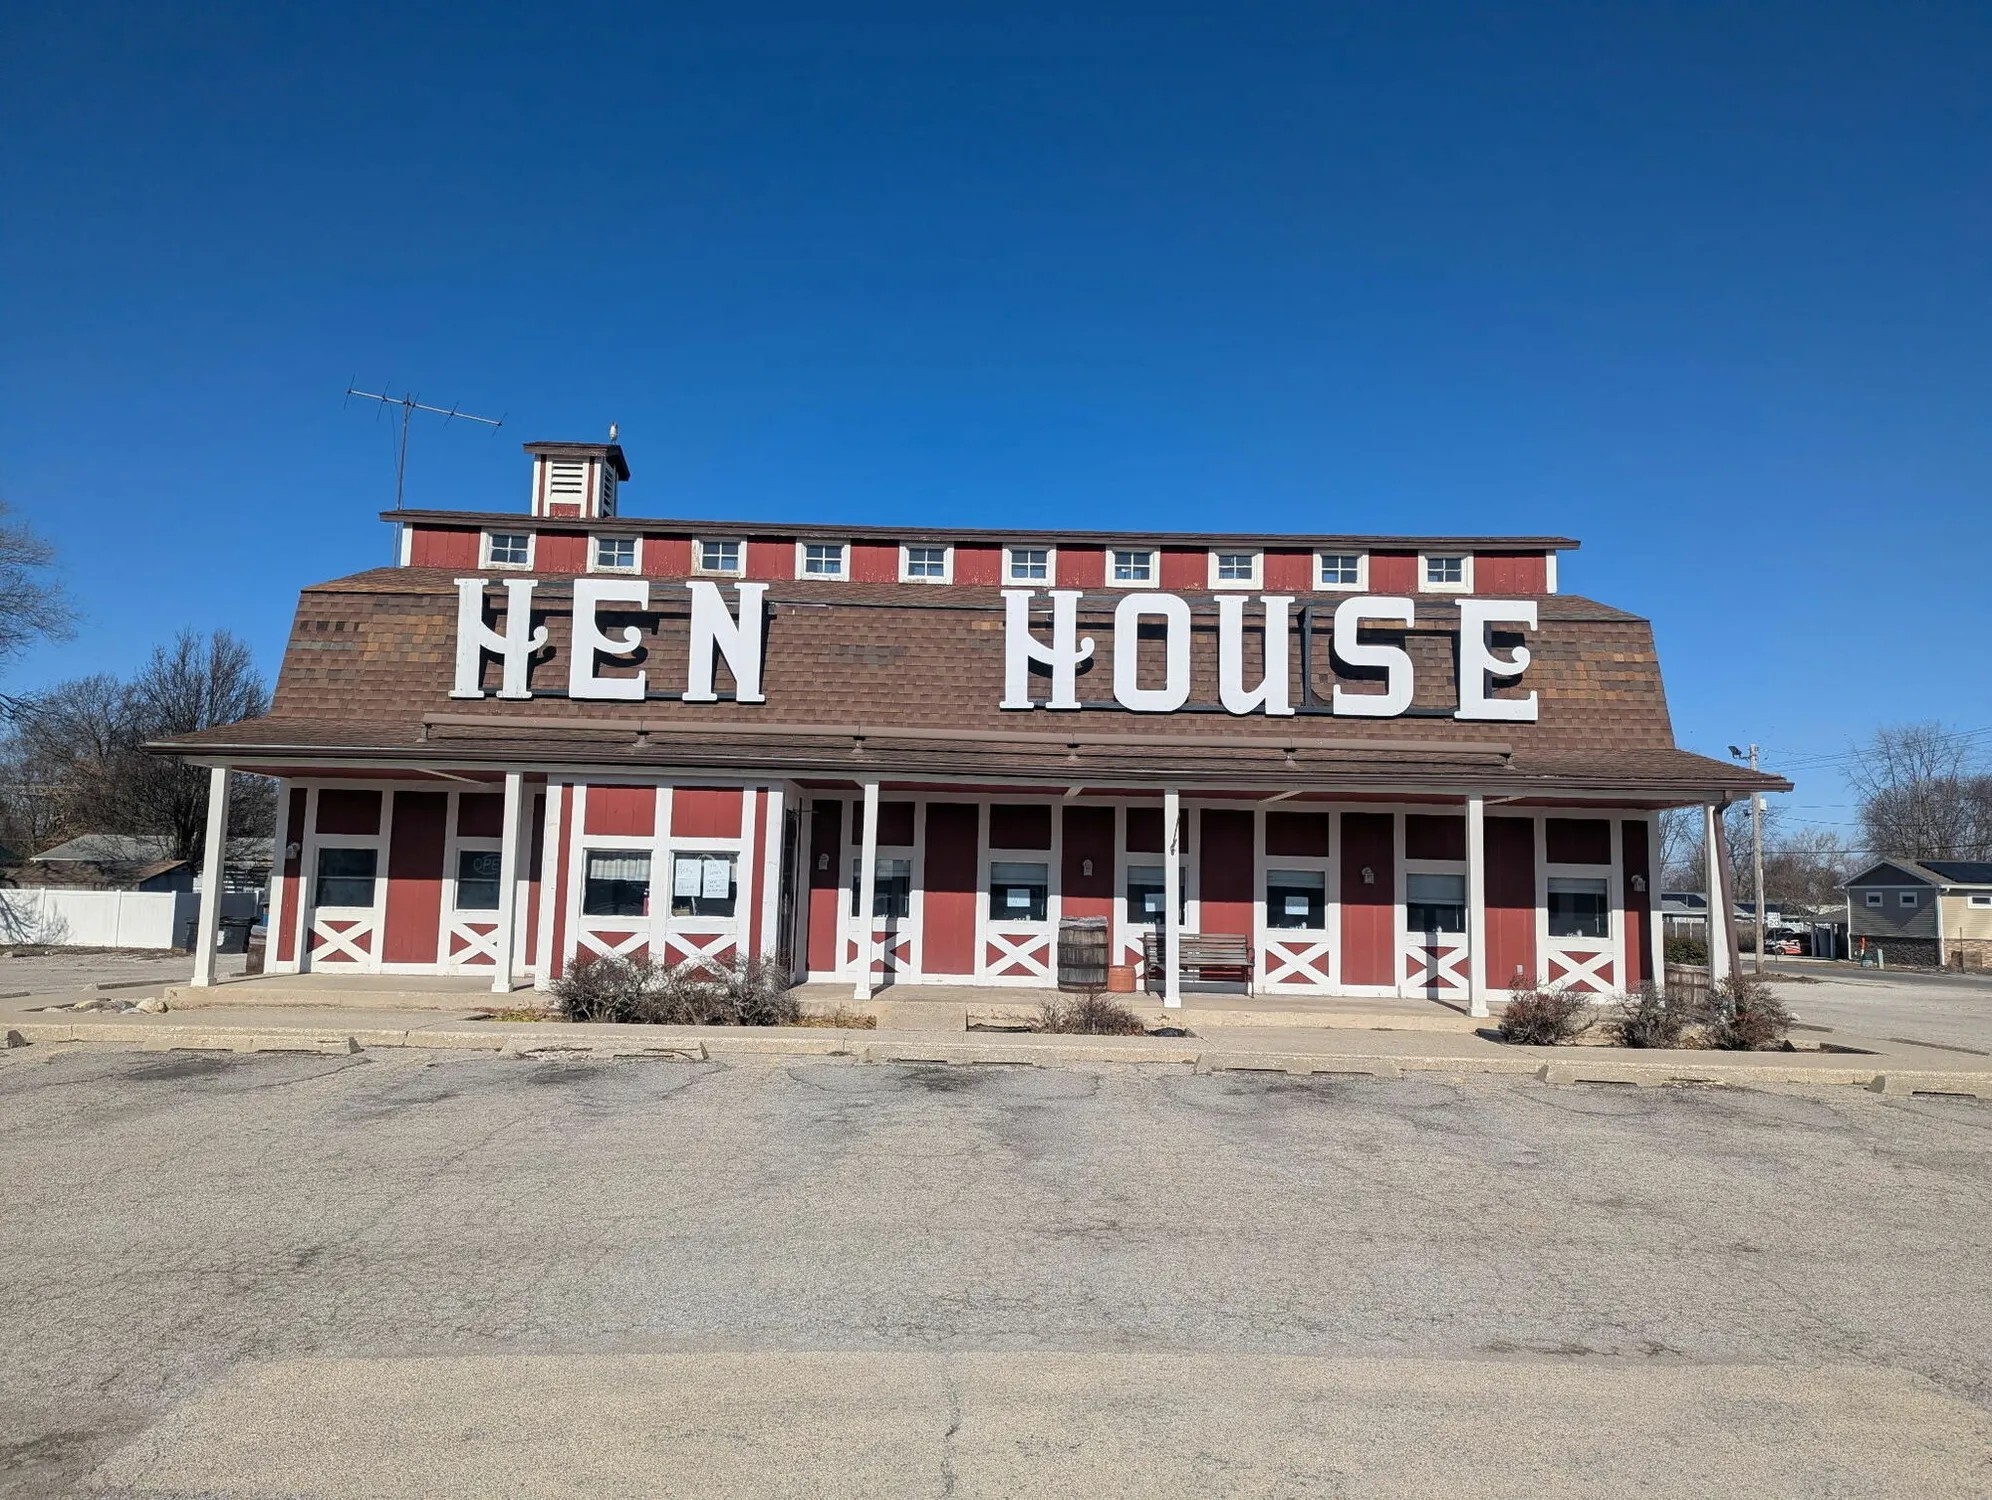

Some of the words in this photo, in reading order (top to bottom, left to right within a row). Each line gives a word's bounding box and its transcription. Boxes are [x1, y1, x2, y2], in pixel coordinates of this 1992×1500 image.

[448, 577, 769, 703] HEN
[999, 588, 1539, 720] HOUSE
[473, 857, 501, 871] OPE
